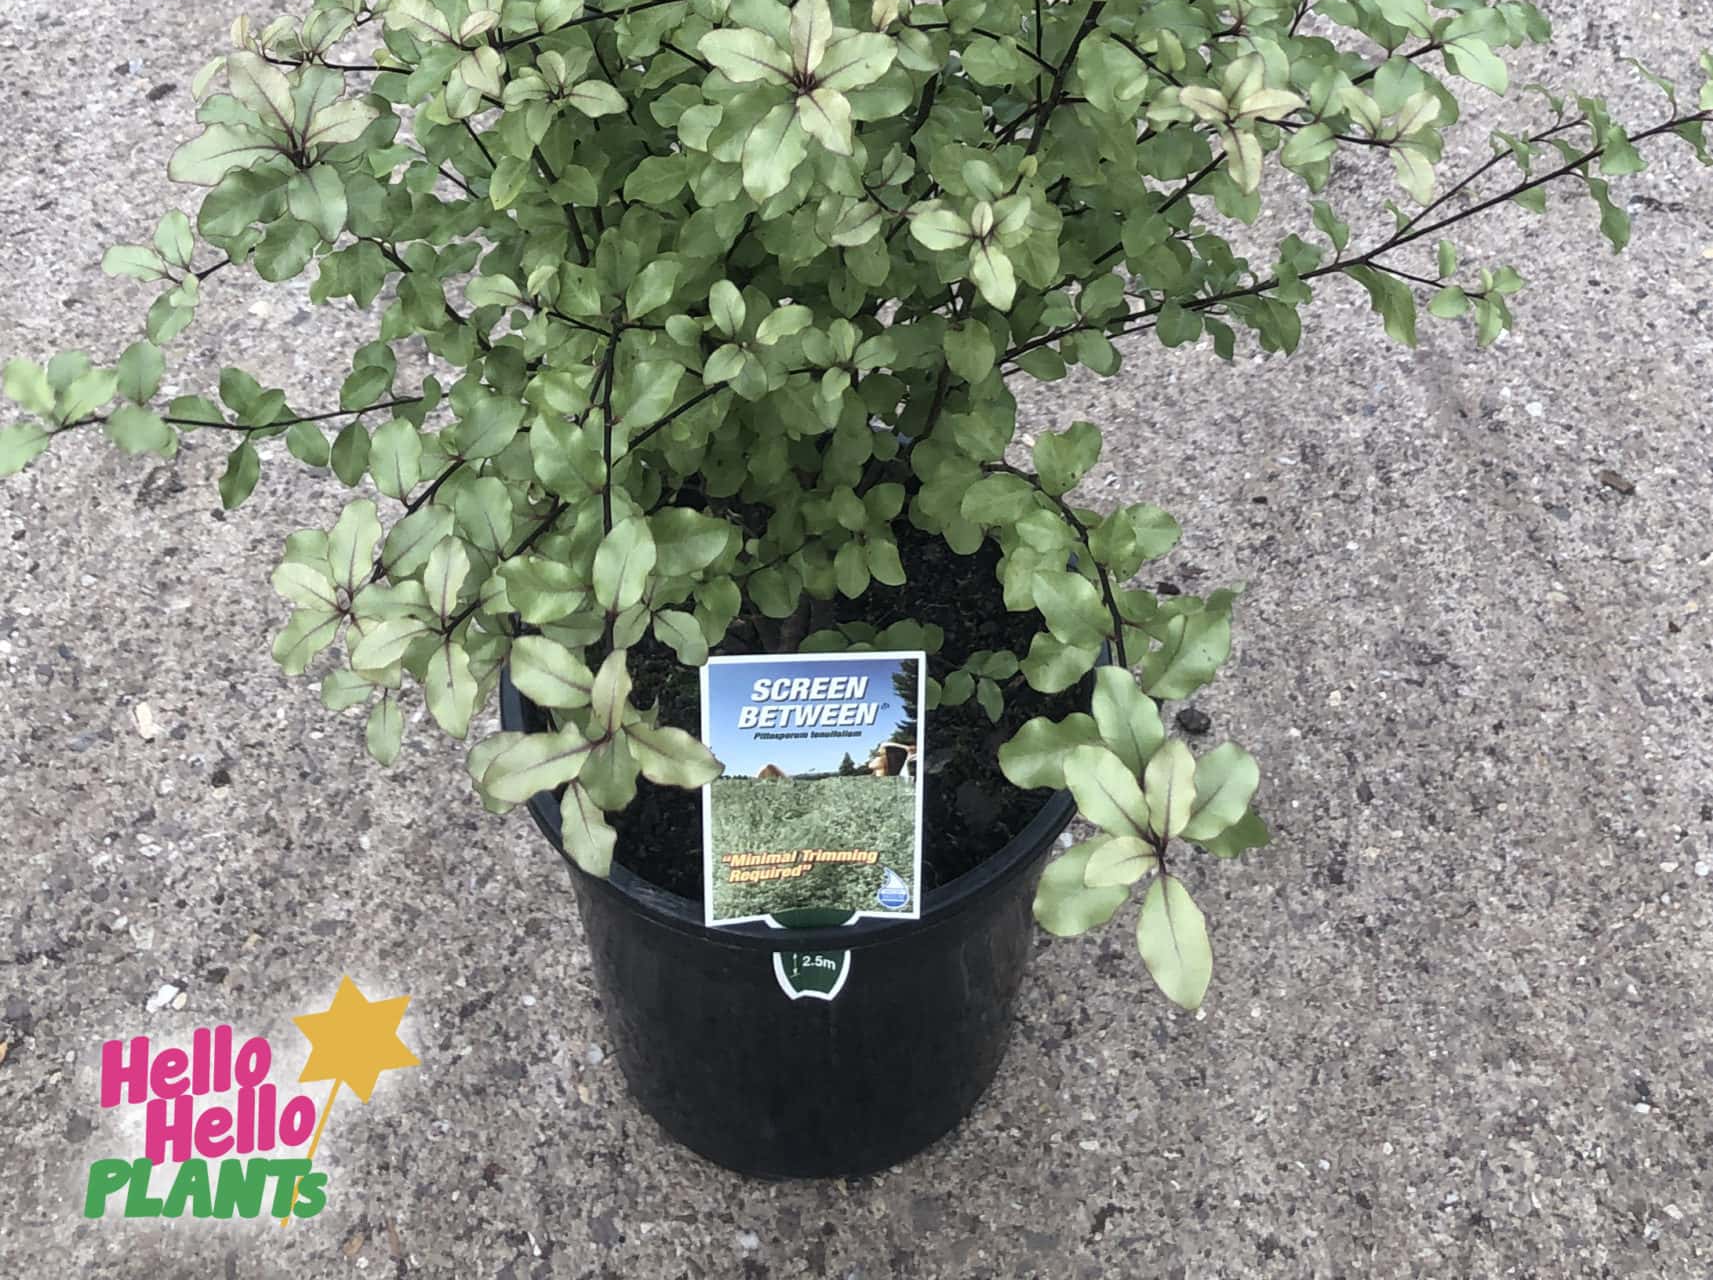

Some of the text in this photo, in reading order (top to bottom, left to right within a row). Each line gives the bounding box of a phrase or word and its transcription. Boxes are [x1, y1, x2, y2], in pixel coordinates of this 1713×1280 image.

[751, 676, 869, 702] SCREEN
[737, 702, 879, 729] BETWEEN
[801, 849, 880, 864] Trimming
[802, 956, 836, 970] 2.5m
